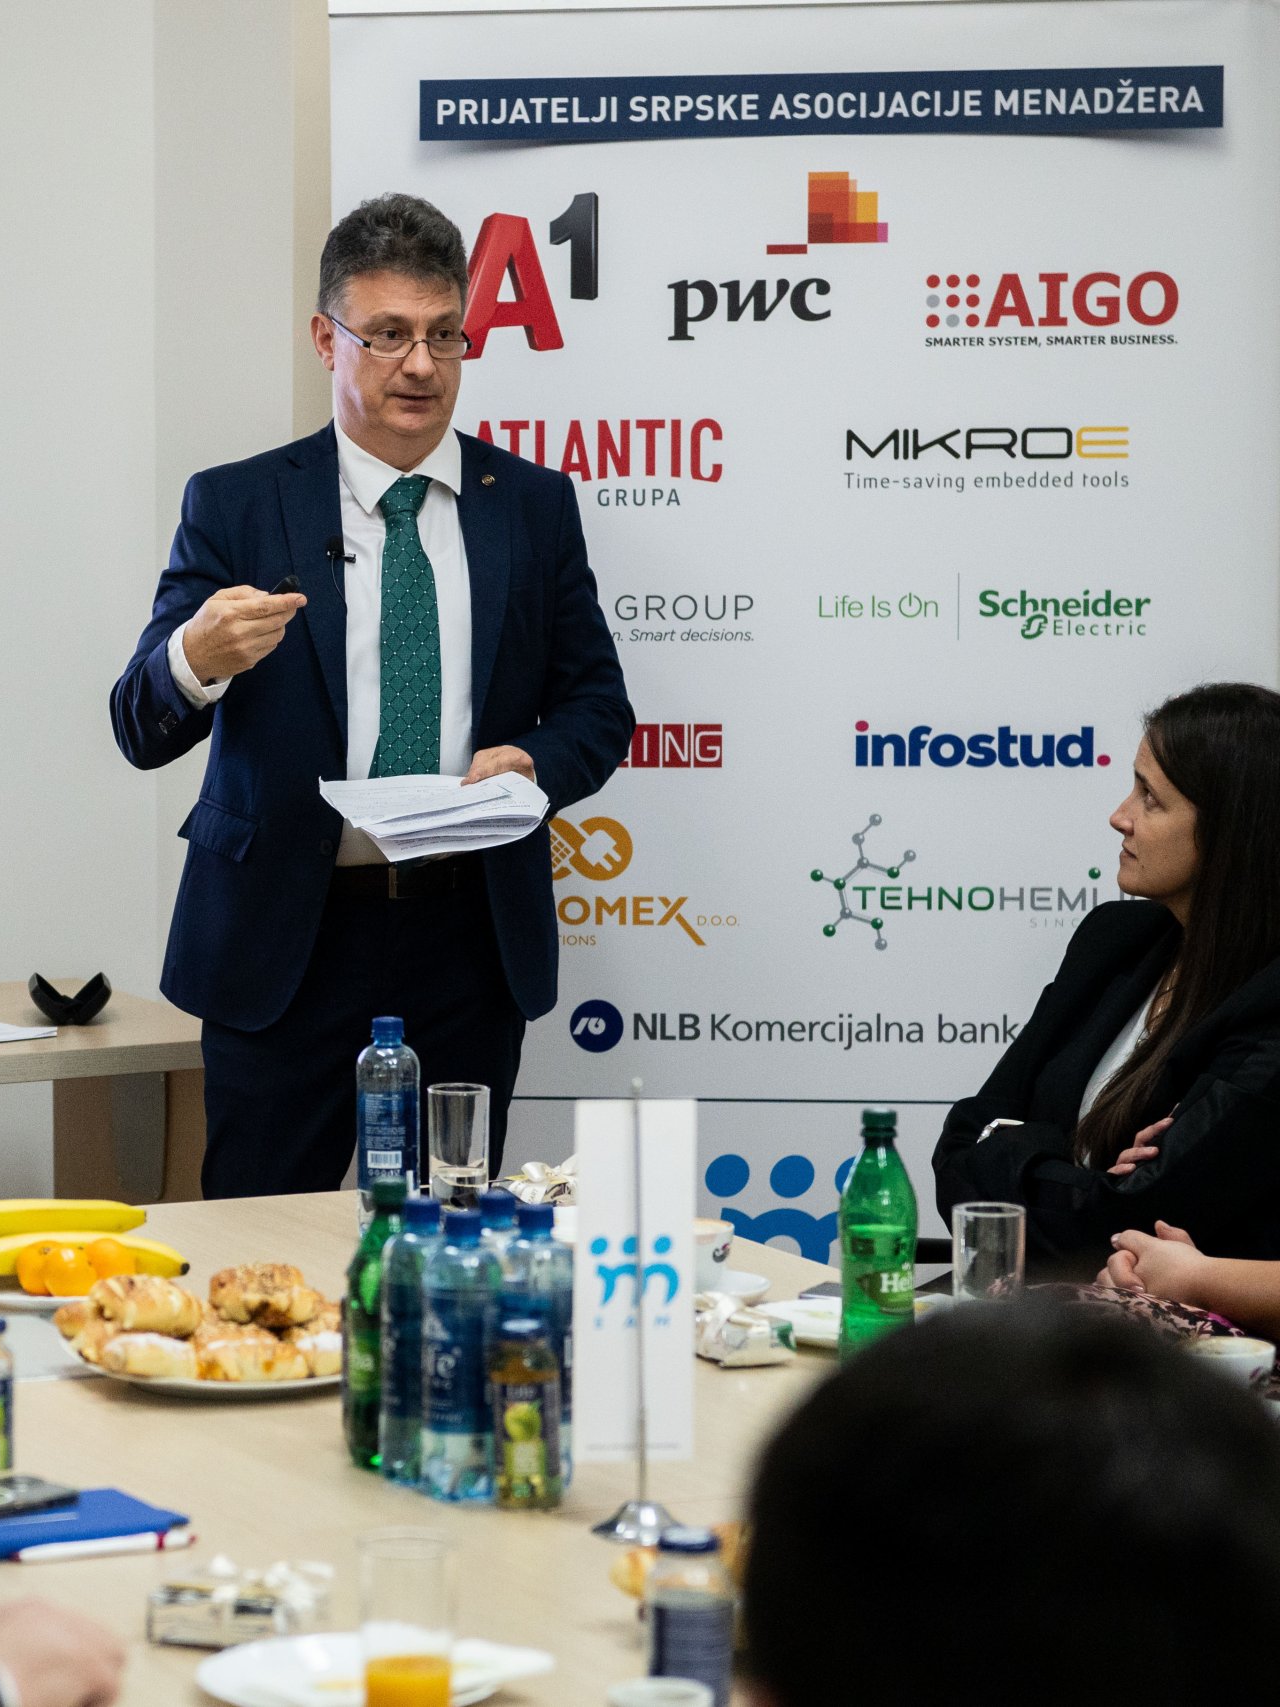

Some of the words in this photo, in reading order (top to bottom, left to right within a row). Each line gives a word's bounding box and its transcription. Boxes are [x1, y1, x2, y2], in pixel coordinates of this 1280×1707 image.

[434, 95, 620, 127] PRIJATELJI
[627, 91, 761, 123] SRPSKE
[767, 87, 984, 121] ASOCIJACIJE
[991, 76, 1206, 119] MENADŽERA
[462, 192, 599, 359] A1
[666, 276, 832, 342] pwc
[983, 269, 1180, 328] AIGO
[924, 336, 985, 347] SMARTER
[988, 336, 1042, 348] SYSTEM,
[1045, 335, 1106, 346] SMARTER
[1110, 334, 1179, 346] BUSINESS.
[846, 426, 1130, 461] MIKROE
[843, 470, 965, 493] Time-saving
[973, 471, 1073, 488] embedded
[1082, 471, 1130, 488] tools
[597, 489, 681, 507] GRUPA
[614, 594, 754, 621] GROUP
[818, 595, 864, 618] Life
[871, 595, 892, 618] Is
[898, 592, 939, 619] On
[978, 589, 1152, 618] Schneider
[629, 629, 676, 642] Smart
[680, 629, 754, 643] decisions.
[1053, 619, 1147, 637] Electric
[854, 719, 1112, 768] infostud.
[696, 915, 741, 927] D.O.O.
[632, 1012, 701, 1041] NLB
[710, 1012, 924, 1050] Komercijalna
[937, 1013, 1025, 1044] bank
